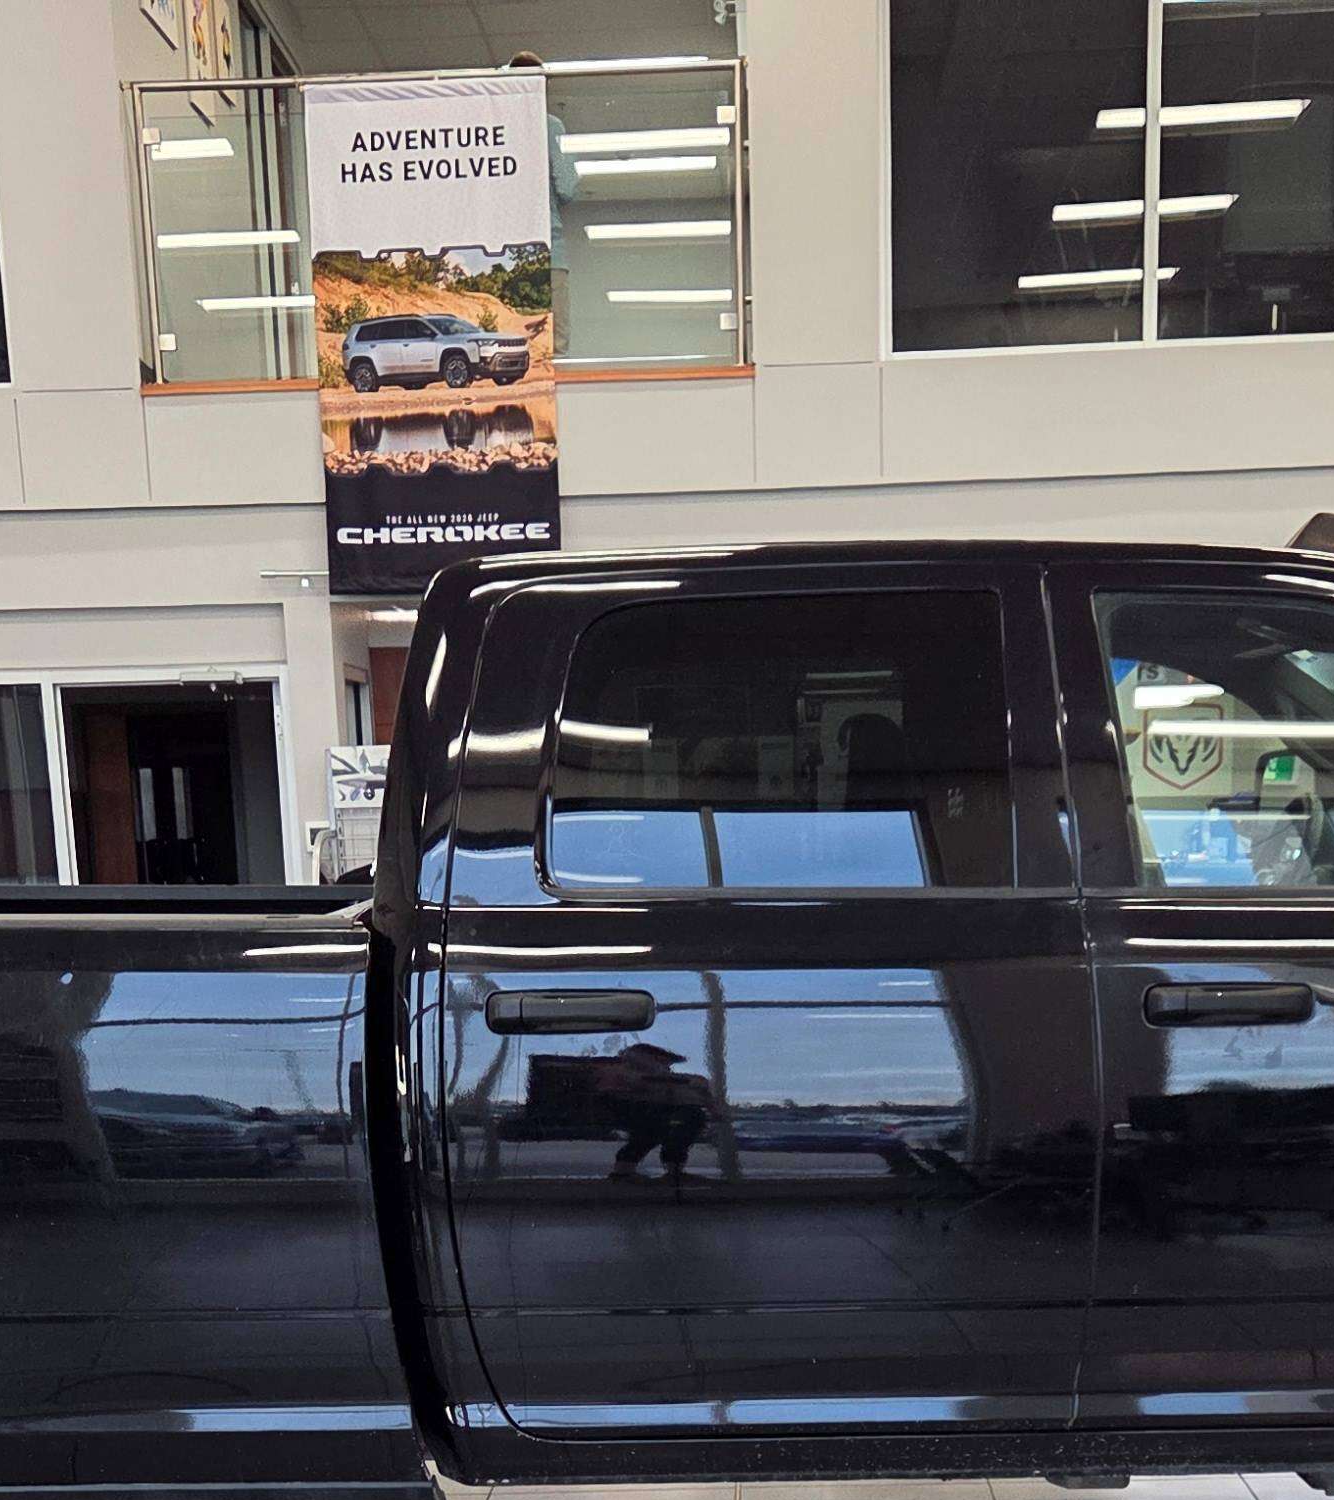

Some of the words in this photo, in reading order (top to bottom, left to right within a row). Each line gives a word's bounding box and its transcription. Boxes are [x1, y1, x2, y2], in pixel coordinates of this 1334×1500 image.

[351, 126, 505, 152] ADVENTURE
[341, 162, 393, 183] HAS
[403, 156, 517, 181] EVOLVED
[407, 514, 422, 524] ALL
[477, 512, 499, 522] JEEP
[337, 522, 551, 545] CHEROKEE
